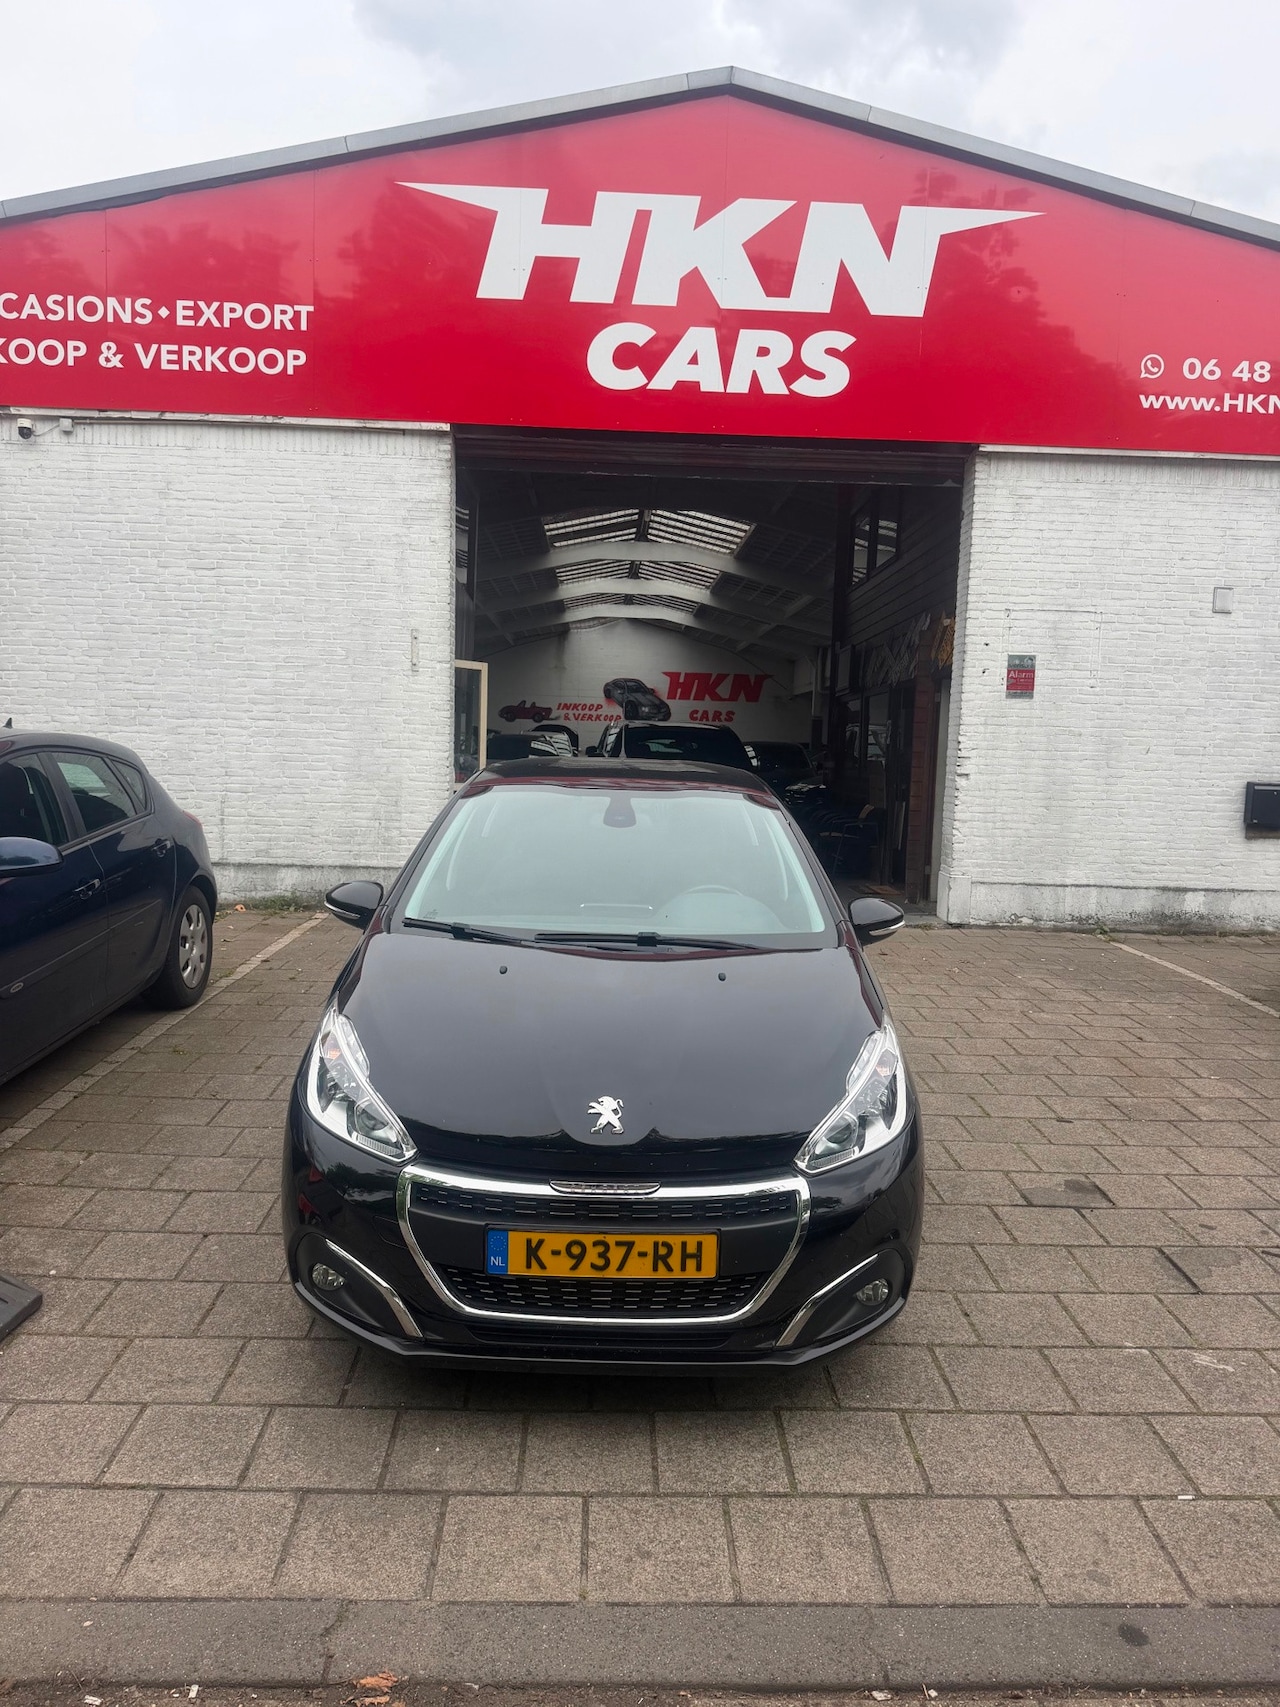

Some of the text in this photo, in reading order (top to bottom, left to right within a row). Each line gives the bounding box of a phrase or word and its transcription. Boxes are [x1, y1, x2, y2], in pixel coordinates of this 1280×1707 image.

[394, 181, 1046, 318] HKN
[175, 299, 315, 332] EXPORT
[98, 341, 125, 369] &
[133, 342, 307, 376] VERKOOP
[586, 321, 857, 398] CARS
[1182, 357, 1271, 383] 06 48
[661, 671, 774, 703] HKN
[556, 702, 603, 712] INKOOP
[563, 713, 622, 722] & VERKOOP
[689, 709, 736, 723] CARS
[490, 1255, 505, 1267] NL
[525, 1237, 704, 1273] K-937-RH
